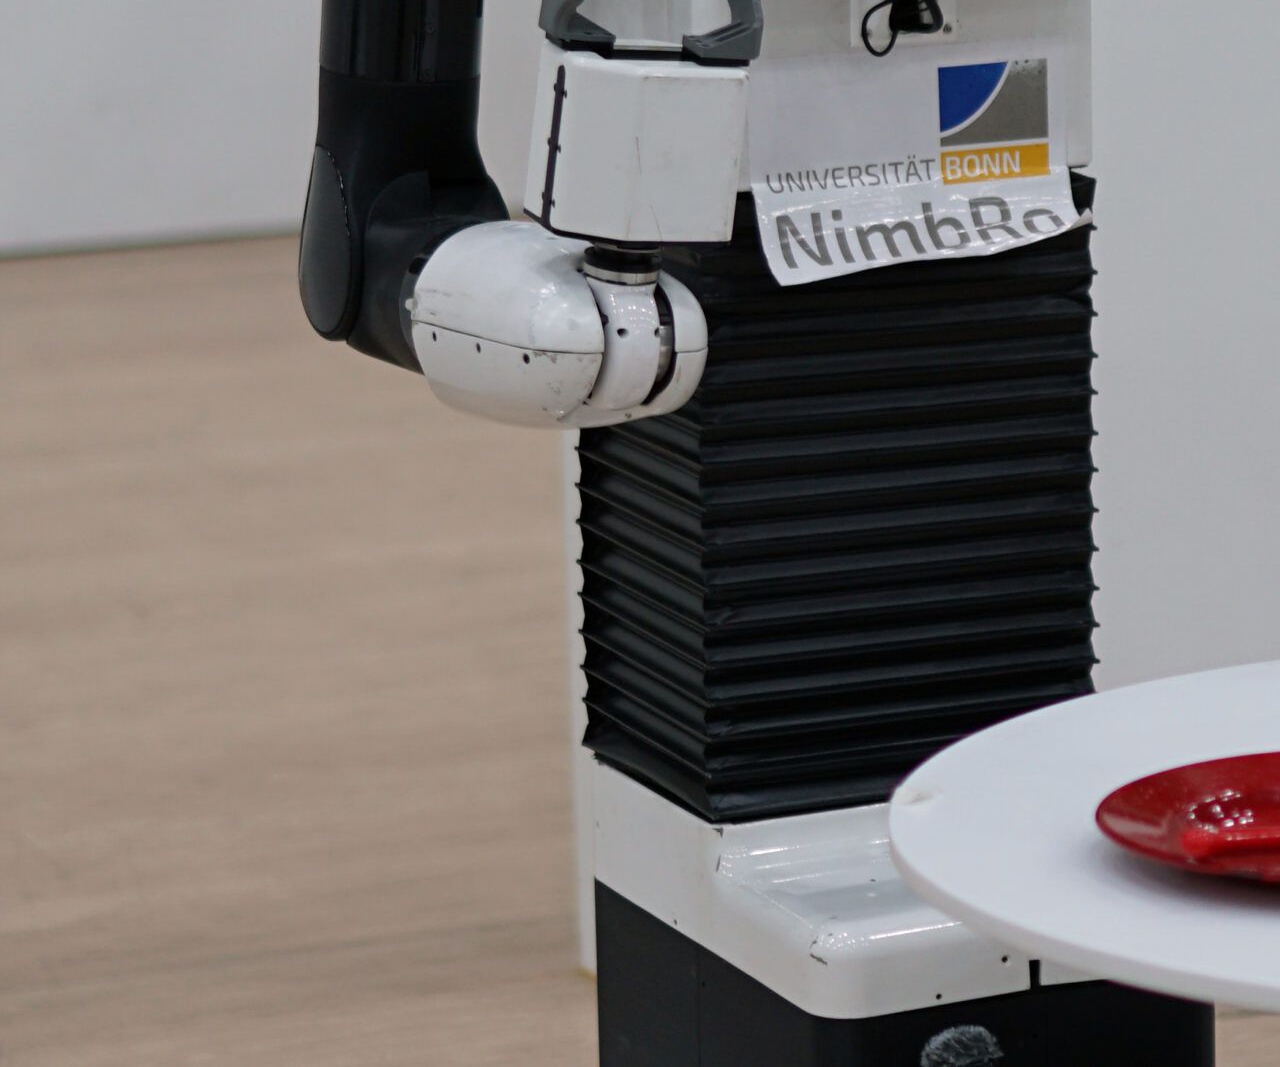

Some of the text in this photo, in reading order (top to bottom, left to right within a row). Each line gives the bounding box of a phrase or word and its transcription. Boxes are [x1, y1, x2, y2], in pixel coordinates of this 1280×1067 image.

[766, 150, 1021, 194] UNIVERSITÄT BONN
[775, 197, 1067, 270] NimbRo
